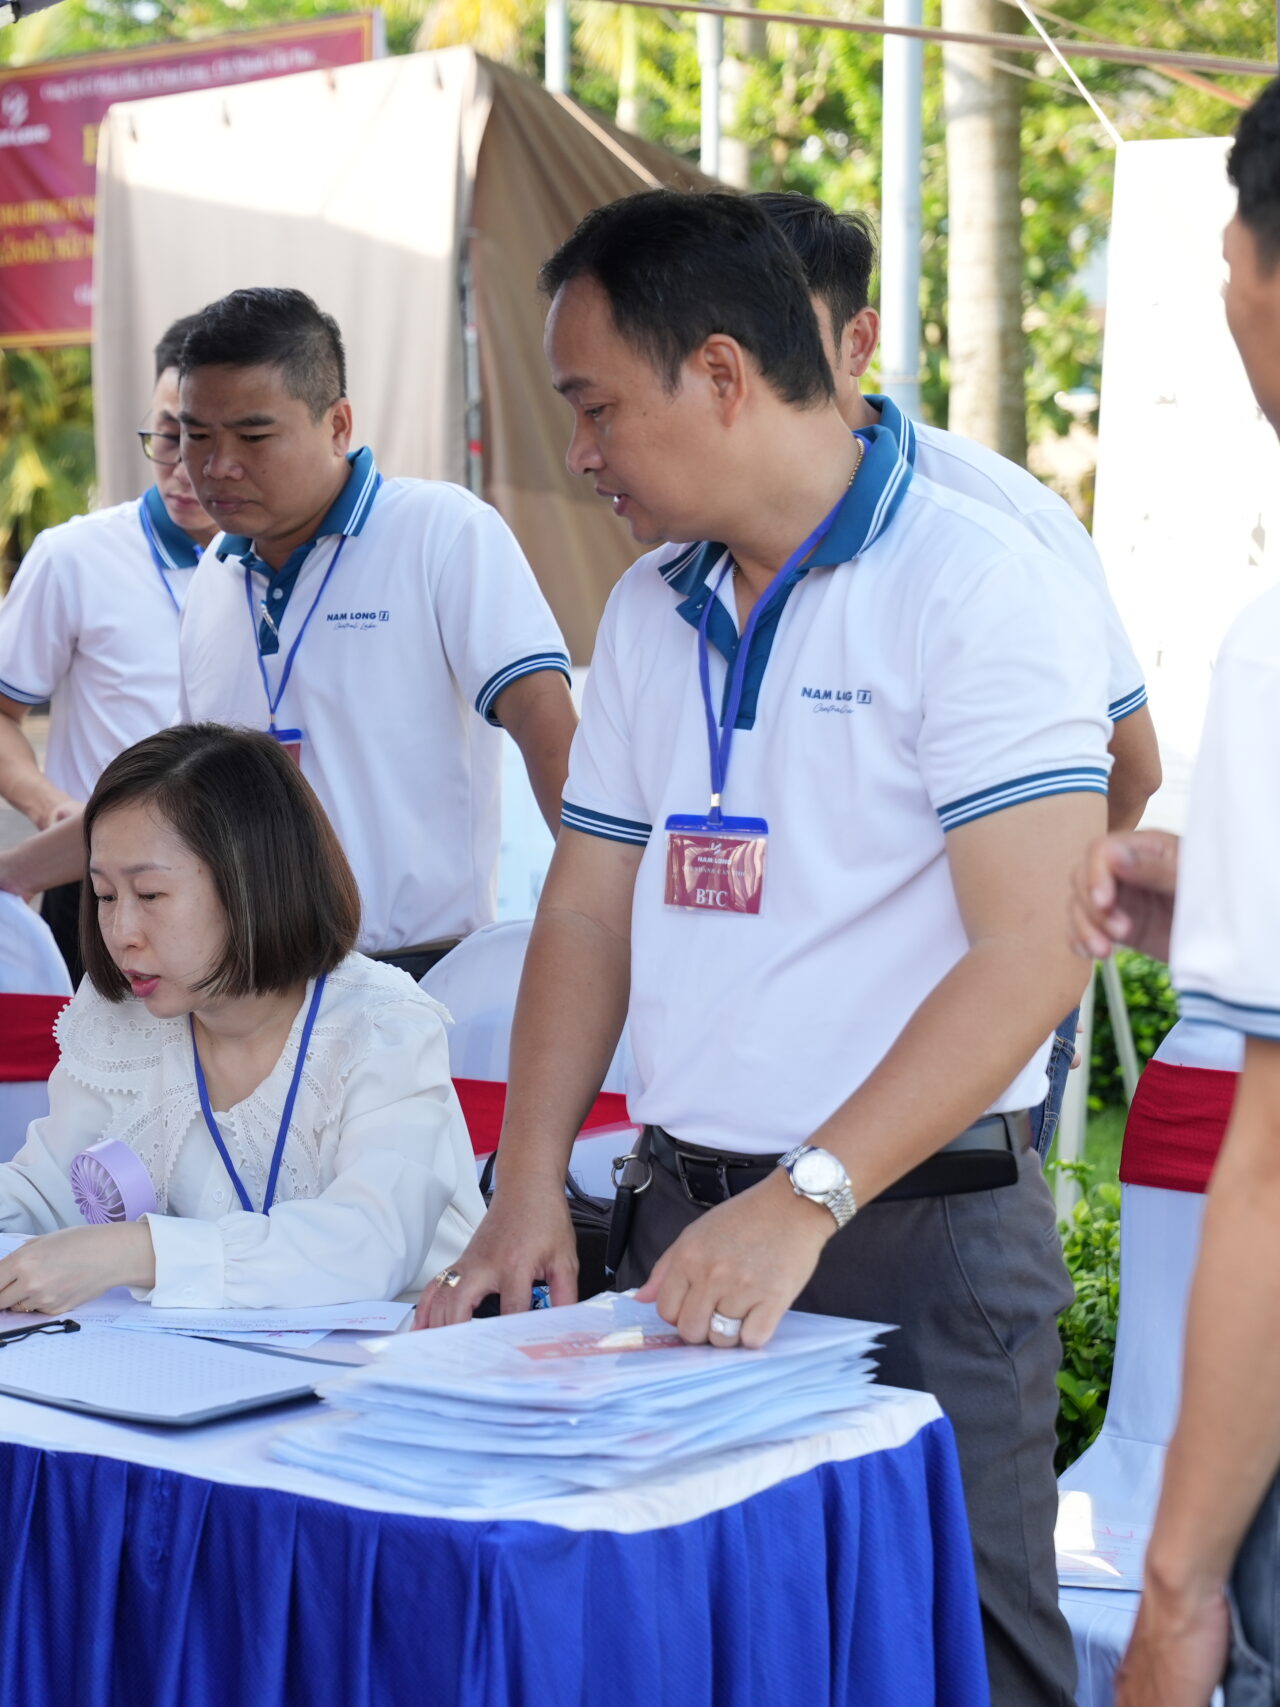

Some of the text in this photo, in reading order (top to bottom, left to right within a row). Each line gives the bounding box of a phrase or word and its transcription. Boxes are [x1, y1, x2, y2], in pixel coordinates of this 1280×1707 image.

[327, 613, 347, 621] NAM
[350, 612, 376, 620] LONG
[801, 687, 832, 700] NAM
[695, 888, 728, 907] BTC
